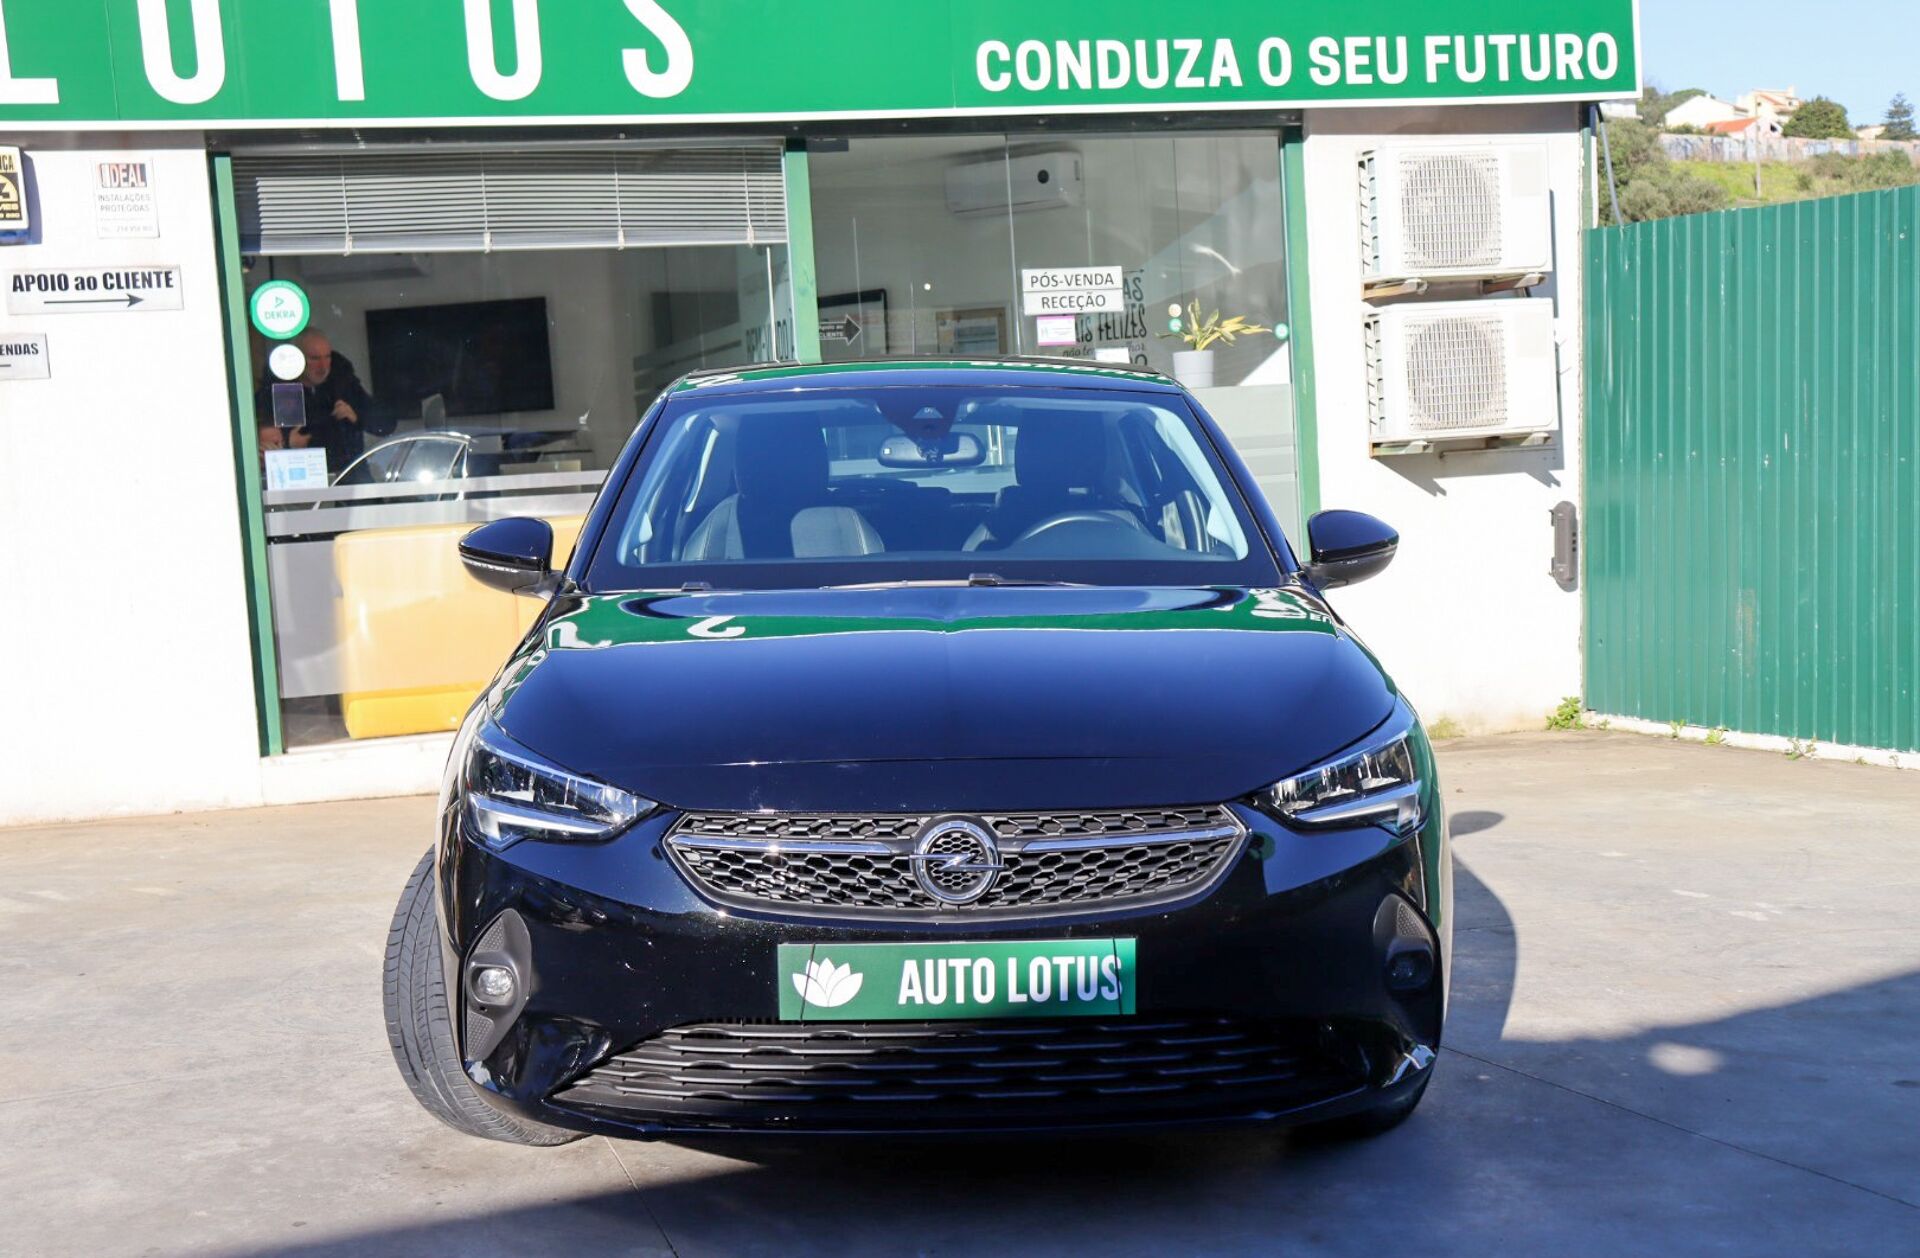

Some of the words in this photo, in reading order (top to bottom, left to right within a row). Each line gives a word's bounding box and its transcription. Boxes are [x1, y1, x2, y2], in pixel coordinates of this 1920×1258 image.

[975, 38, 1243, 92] CONDUZA
[1257, 38, 1293, 87] O
[1308, 36, 1409, 86] SEU
[1425, 32, 1618, 84] FUTURO
[97, 163, 147, 188] IDEAL
[12, 273, 69, 292] APOIO
[74, 276, 98, 291] ao
[102, 270, 174, 290] CLIENTE
[1030, 271, 1115, 288] PÓS-VENDA
[1041, 292, 1106, 310] RECEÇÃO
[264, 309, 296, 320] DEKRA
[1098, 303, 1147, 341] FELIZES
[898, 957, 996, 1005] AUTO
[1008, 954, 1123, 1003] LOTUS
